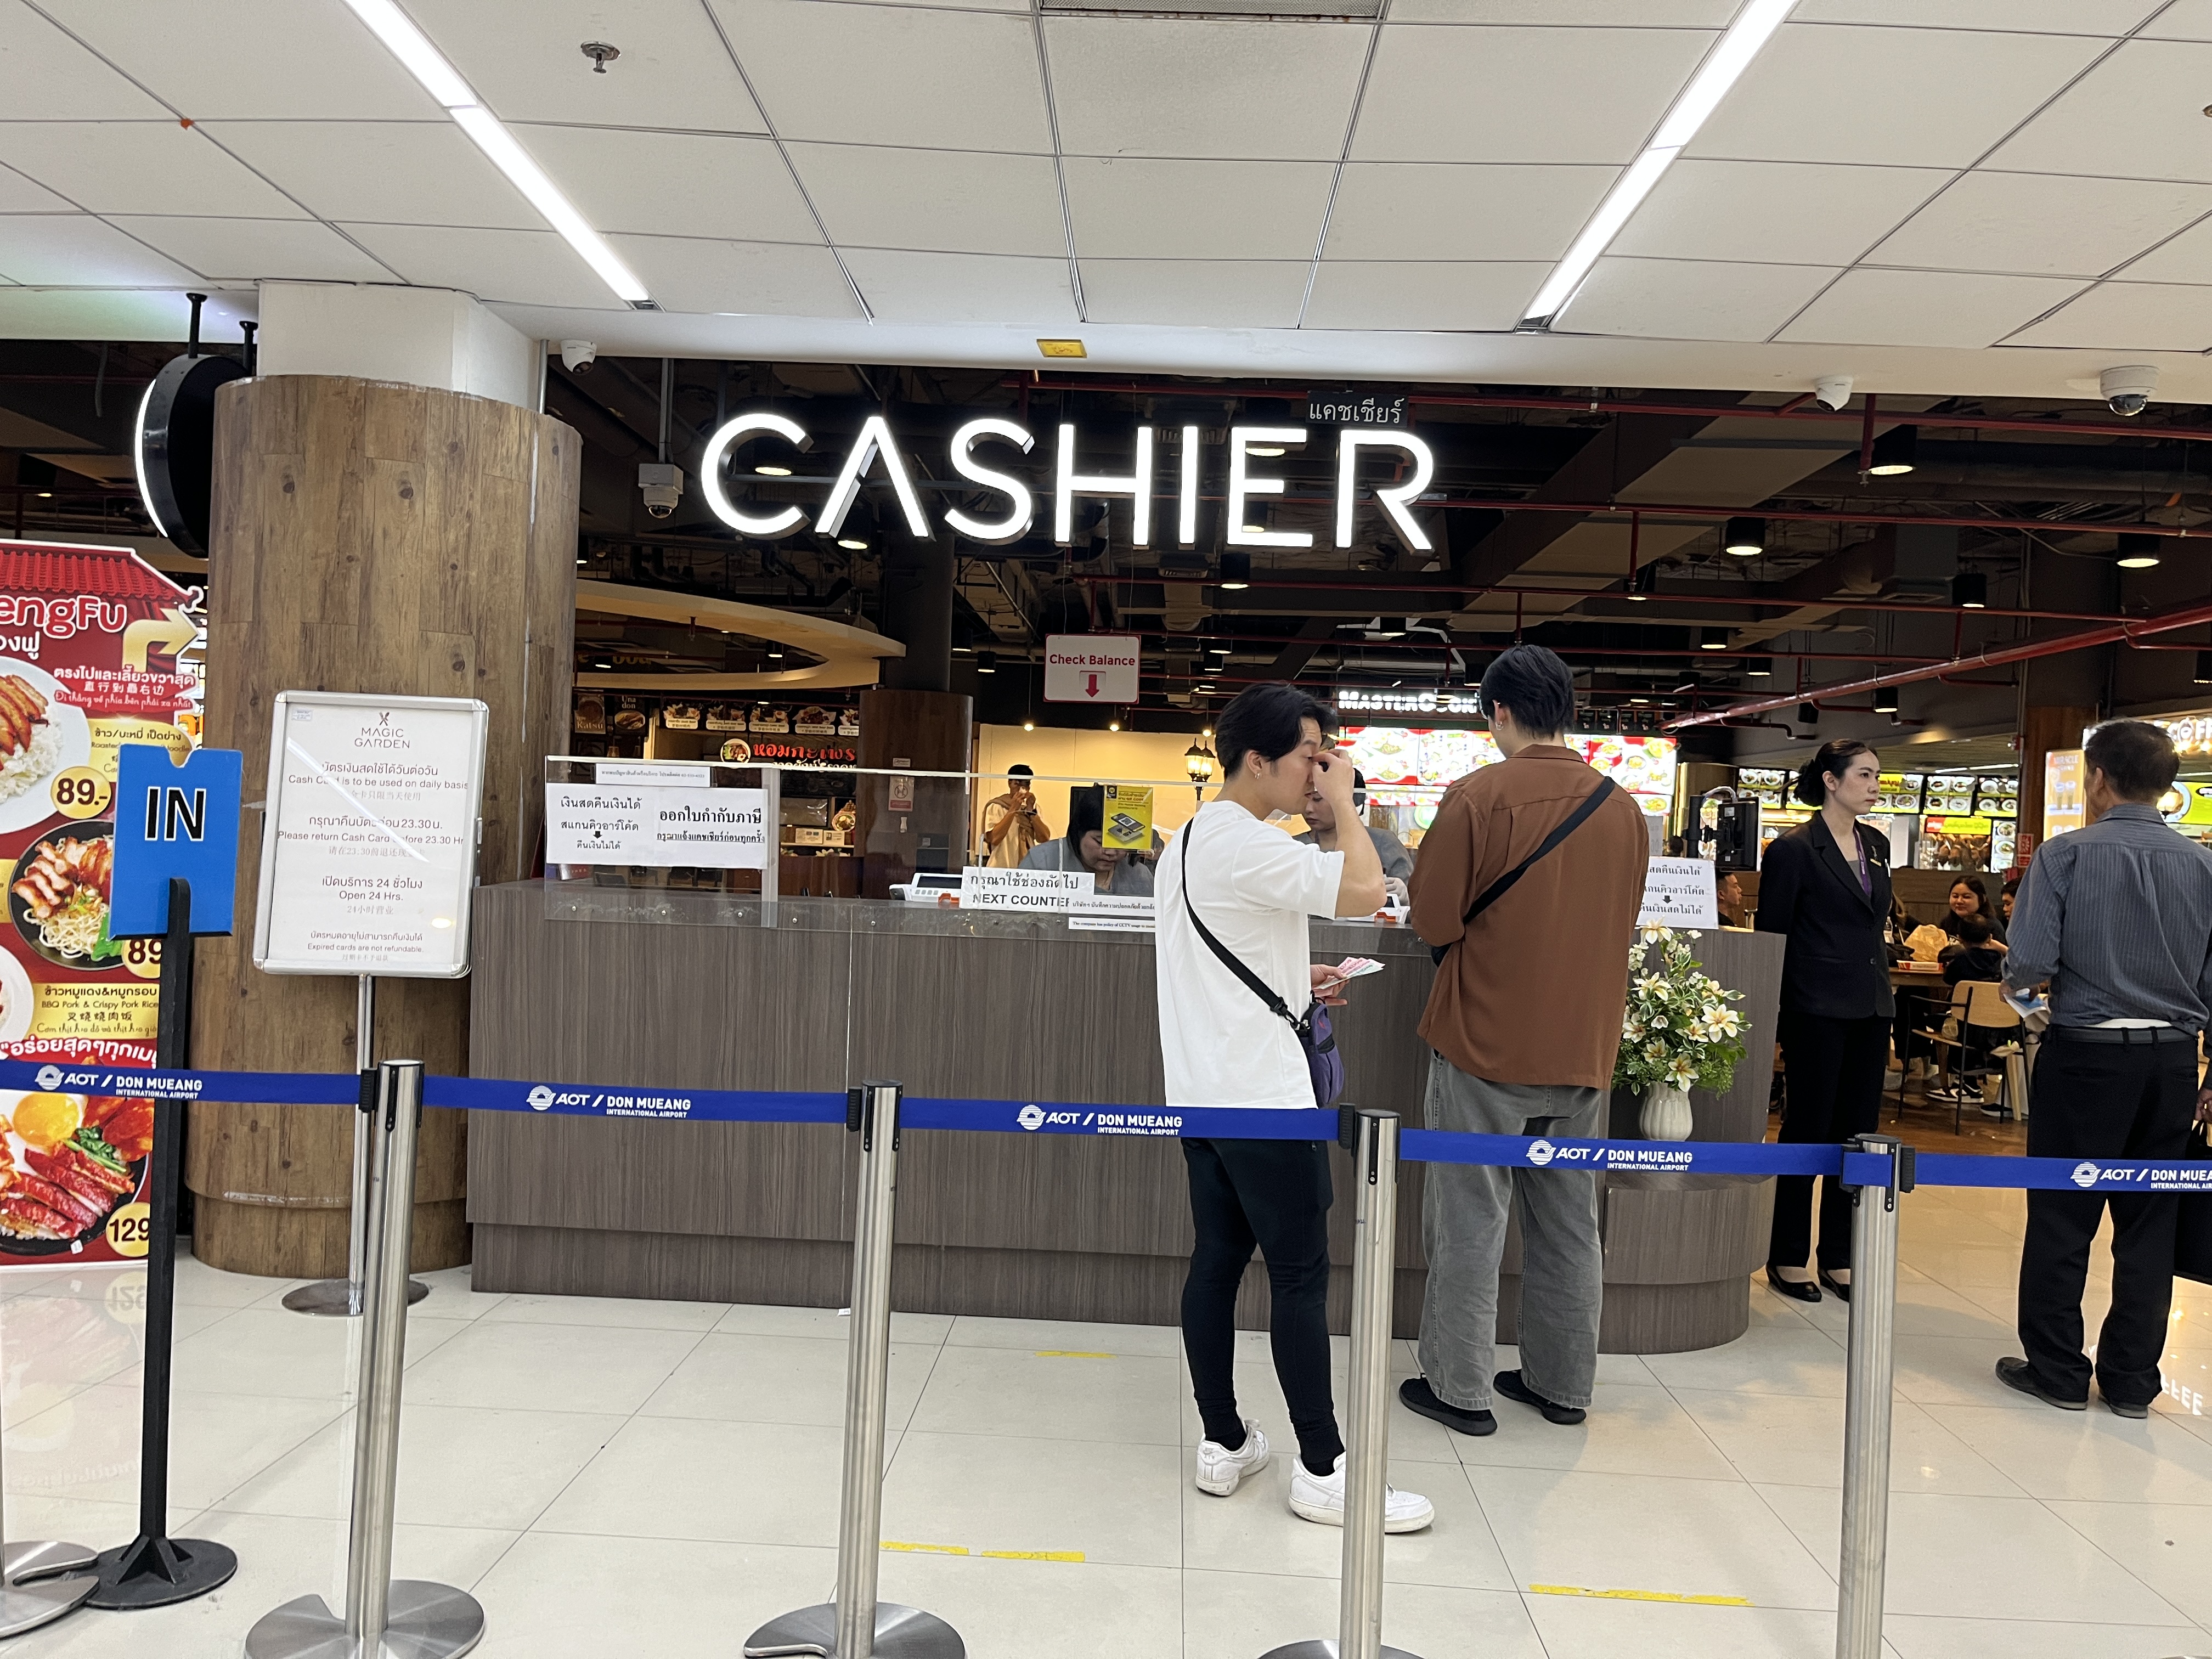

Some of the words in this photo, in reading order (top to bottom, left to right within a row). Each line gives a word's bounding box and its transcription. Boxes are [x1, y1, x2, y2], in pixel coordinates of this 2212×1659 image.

[1310, 398, 1404, 424] แคชเชียร์
[701, 414, 1432, 550] CASHIER
[1049, 654, 1086, 664] Check
[1089, 655, 1135, 665] Balance
[54, 665, 196, 689] ตรงไปและเลี้ยวขวาสุด
[361, 727, 404, 738] MAGIC
[354, 738, 410, 749] GARDEN
[289, 775, 313, 785] Cash
[342, 777, 350, 785] is
[353, 777, 362, 786] to
[365, 778, 376, 787] be
[380, 778, 402, 787] used
[420, 780, 442, 790] daily
[444, 781, 468, 790] basis
[561, 795, 642, 809] เงินสดคืนเงินได้
[145, 786, 206, 841] IN
[659, 805, 761, 824] ออกใบกำกับภาษี
[561, 819, 639, 831] สแกนคิวอาร์โค้ด
[278, 831, 309, 840] Please
[311, 833, 338, 841] return
[342, 833, 365, 842] Cash
[425, 836, 451, 844] 23.30
[657, 830, 766, 844] กรุณาแจ้งแคชเชียร์ก่อนทุกครั้ง
[577, 839, 622, 850] คืนเงินไม่ได้
[1648, 864, 1702, 876] สดคืนเงินได้
[322, 875, 374, 888] เปิดบริการ
[376, 878, 390, 888] 24
[393, 874, 423, 889] ชั่วโมง
[969, 871, 1079, 890] กรุณาใช้ช่องถัดไป
[339, 890, 366, 901] Open
[369, 891, 381, 900] 24
[384, 891, 404, 901] Hrs.
[972, 893, 1007, 905] NEXT
[307, 943, 335, 951] Expired
[44, 986, 157, 999] ข้าวหมูแดง&หมูกรอบ
[62, 1000, 80, 1008] Pork
[93, 1000, 119, 1011] Crispy
[121, 1000, 139, 1008] Pork
[64, 1073, 99, 1086] AOT
[116, 1075, 143, 1088] DON
[146, 1077, 202, 1092] MUEANG
[116, 1089, 168, 1098] INTERNATIONAL
[168, 1091, 199, 1099] AIRPORT
[555, 1093, 590, 1105] AOT
[607, 1096, 633, 1108] DON
[636, 1097, 691, 1110] MUEANG
[606, 1109, 658, 1117] INTERNATIONAL
[1046, 1112, 1081, 1124] AOT
[1098, 1114, 1124, 1126] DON
[1127, 1115, 1182, 1127] MUEANG
[1555, 1148, 1591, 1160] AOT
[1607, 1149, 1635, 1161] DON
[1638, 1150, 1693, 1163] MUEANG
[2100, 1169, 2135, 1181] AOT
[2151, 1169, 2178, 1181] DON
